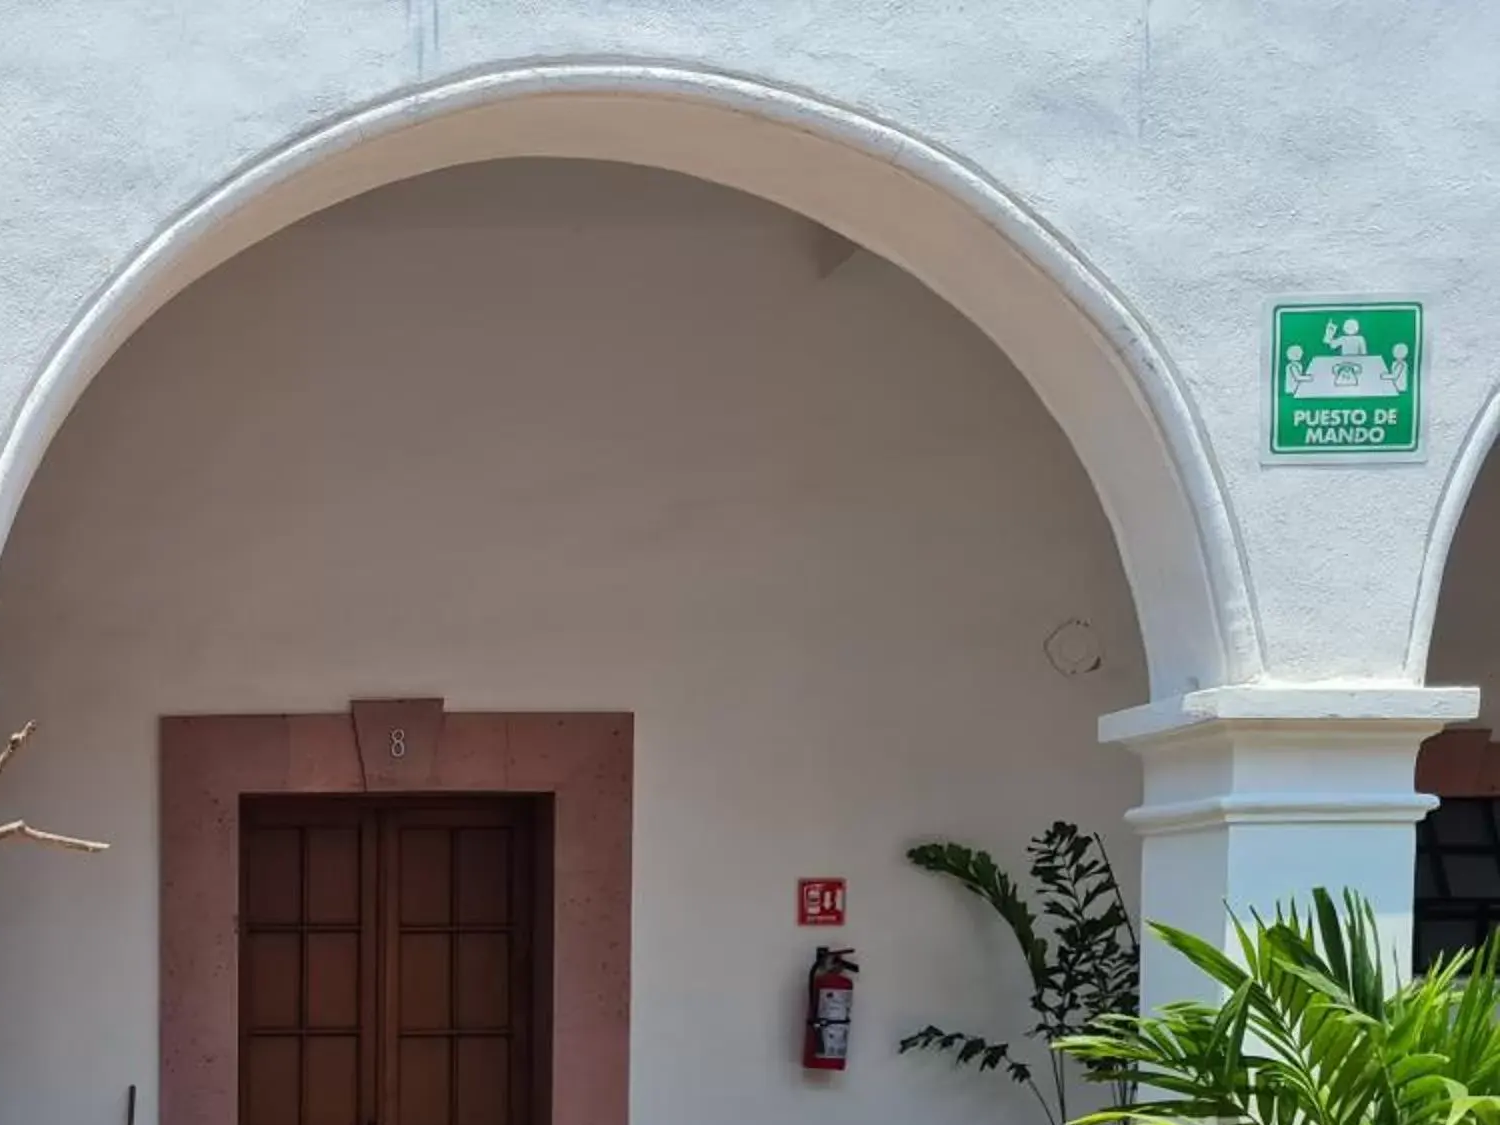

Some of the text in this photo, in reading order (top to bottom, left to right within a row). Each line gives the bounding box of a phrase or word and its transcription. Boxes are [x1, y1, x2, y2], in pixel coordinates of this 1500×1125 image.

[1293, 409, 1398, 427] PUESTO DE
[1305, 427, 1385, 445] MANDO
[391, 728, 405, 757] 8
